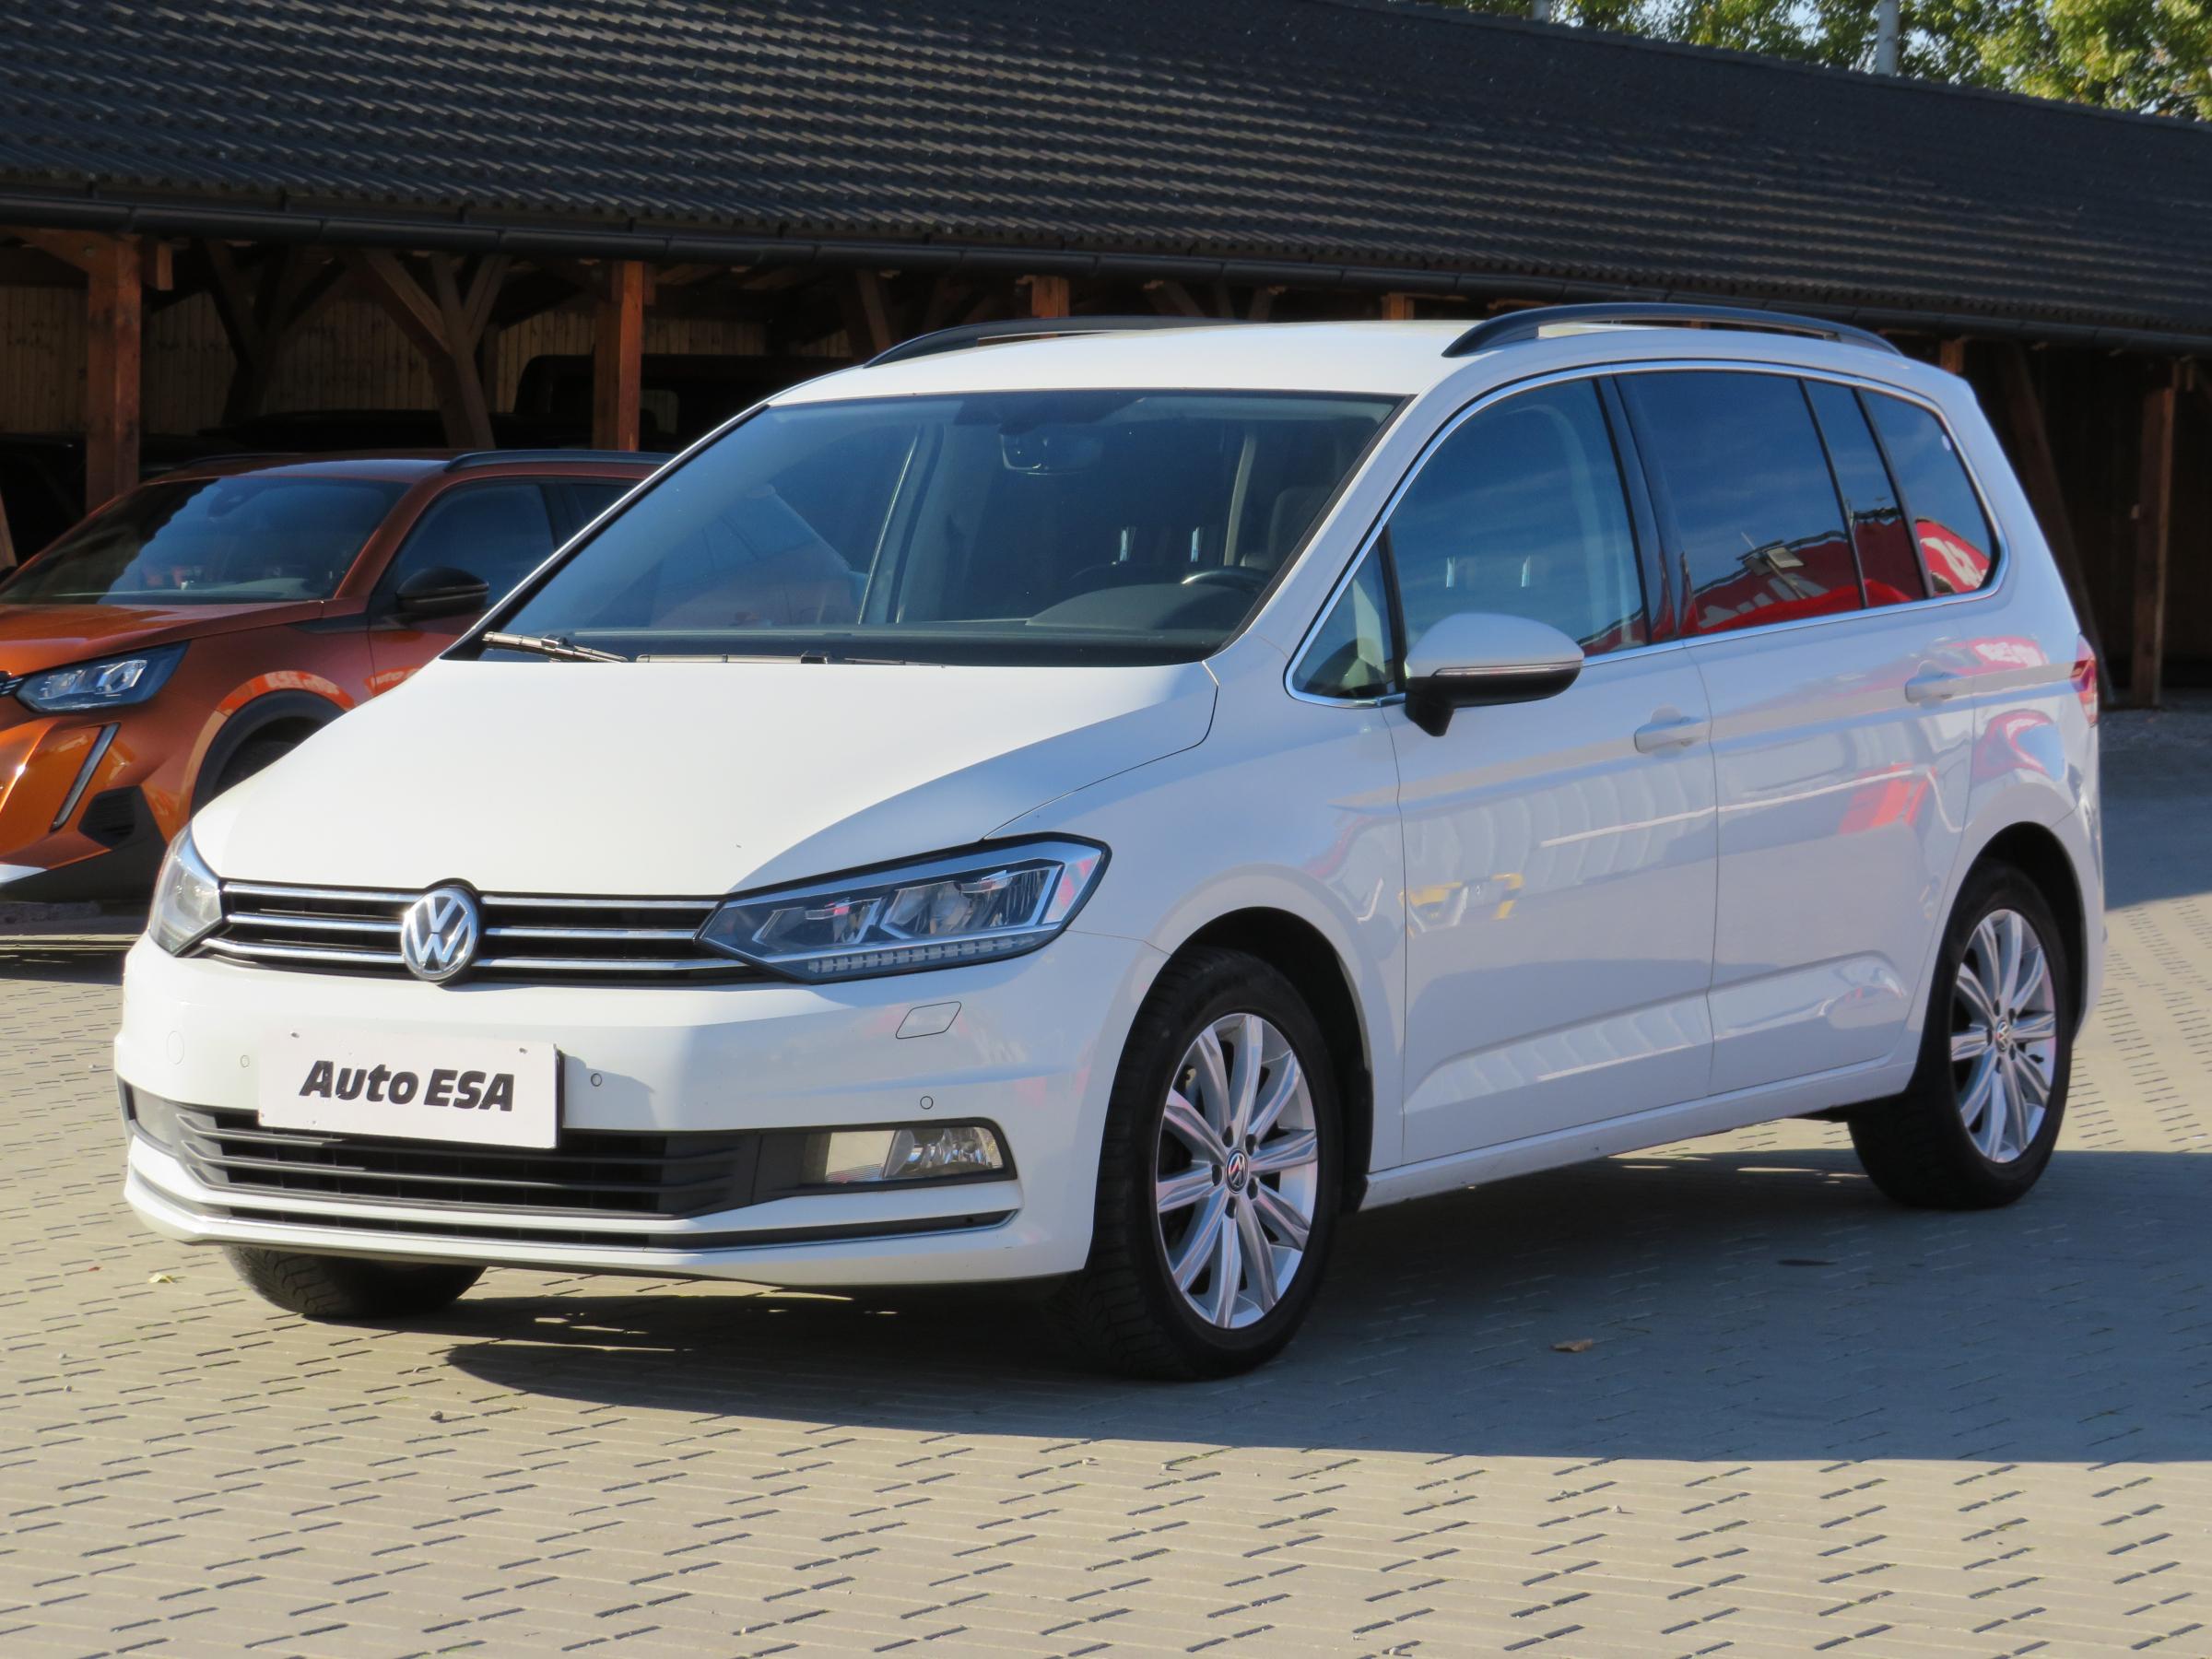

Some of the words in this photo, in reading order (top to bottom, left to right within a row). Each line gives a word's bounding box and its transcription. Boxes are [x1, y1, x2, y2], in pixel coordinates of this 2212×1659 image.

[404, 889, 476, 975] VW
[300, 1061, 418, 1104] Auto
[424, 1069, 514, 1111] ESA
